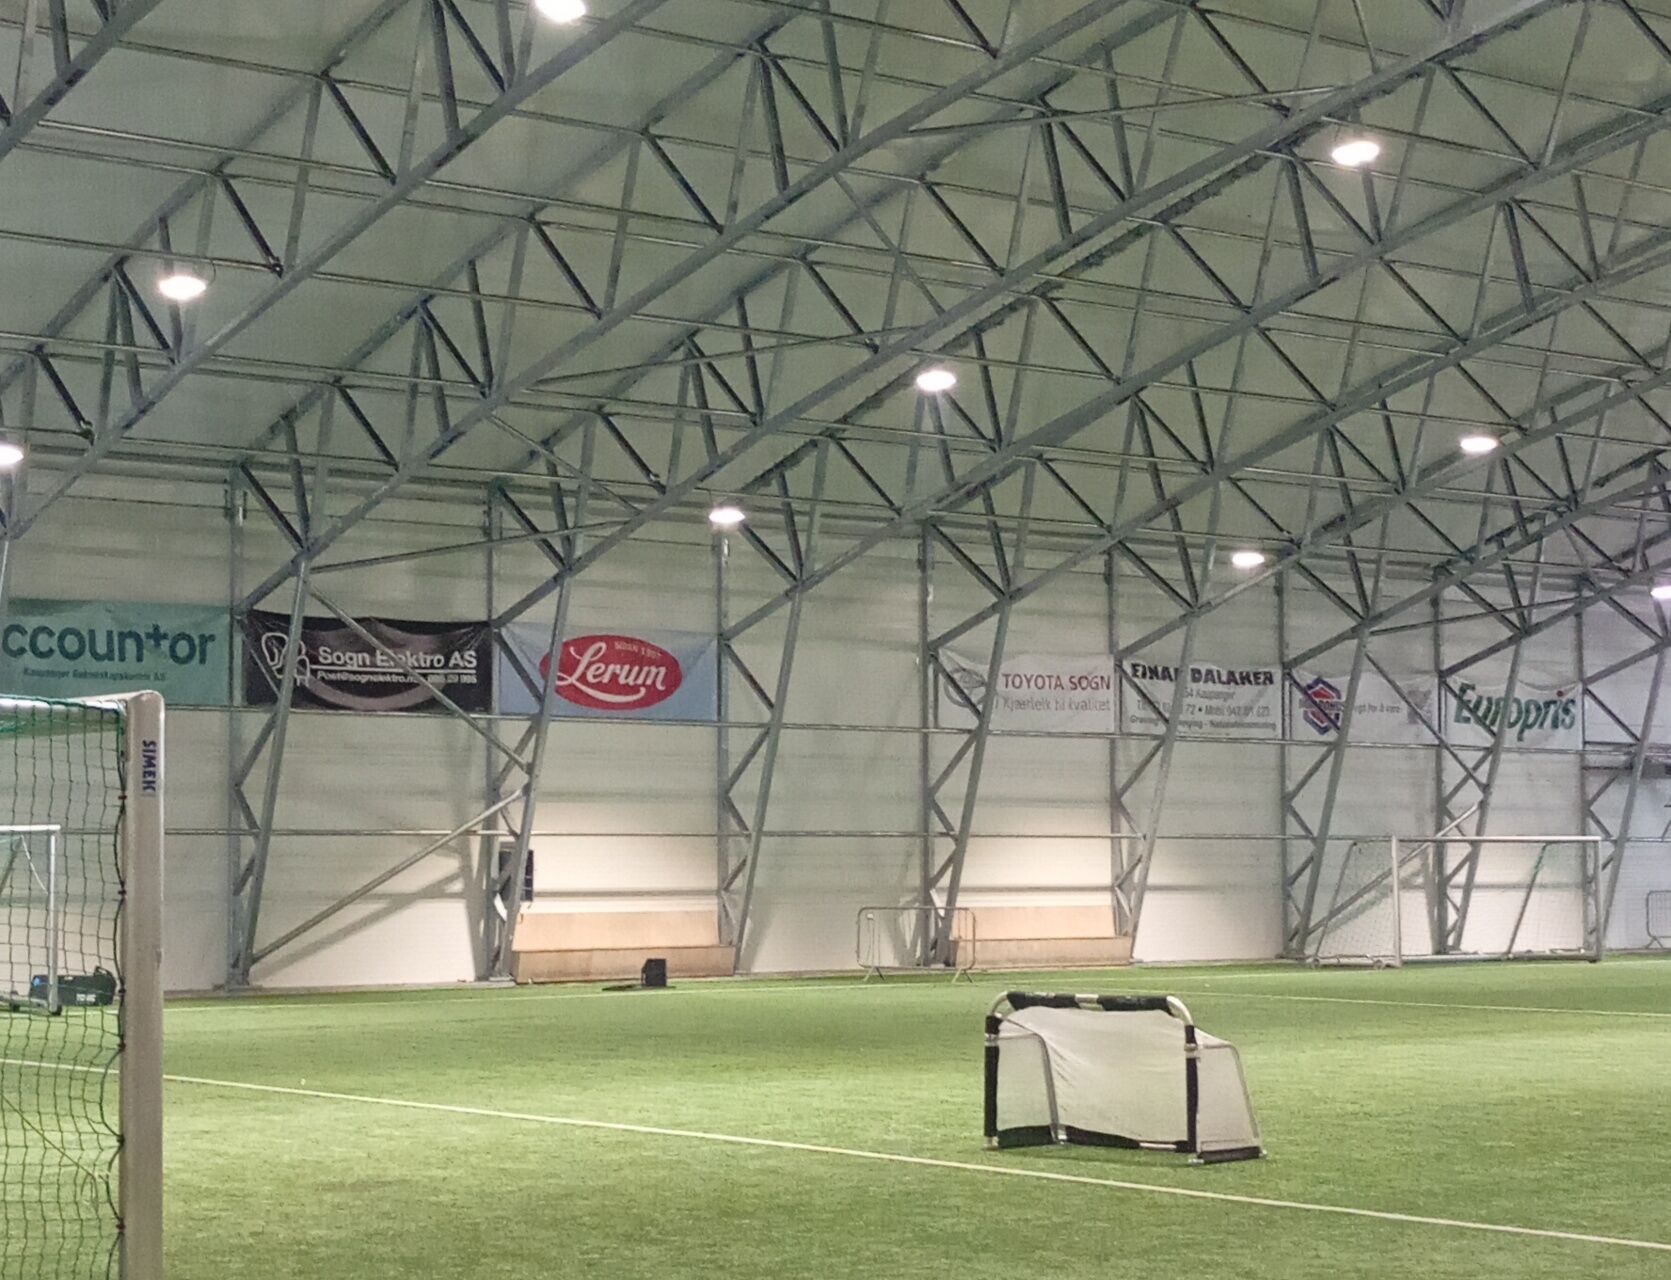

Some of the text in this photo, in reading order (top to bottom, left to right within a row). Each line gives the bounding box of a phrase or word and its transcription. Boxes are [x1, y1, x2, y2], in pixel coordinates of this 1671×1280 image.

[318, 647, 370, 668] Sogn
[449, 650, 477, 668] AS
[556, 642, 667, 703] Lerum
[1001, 673, 1111, 691] TOYOTA SOGN
[1190, 668, 1274, 686] DALAKER
[1454, 682, 1576, 742] Europris
[142, 738, 157, 793] SIMEK
